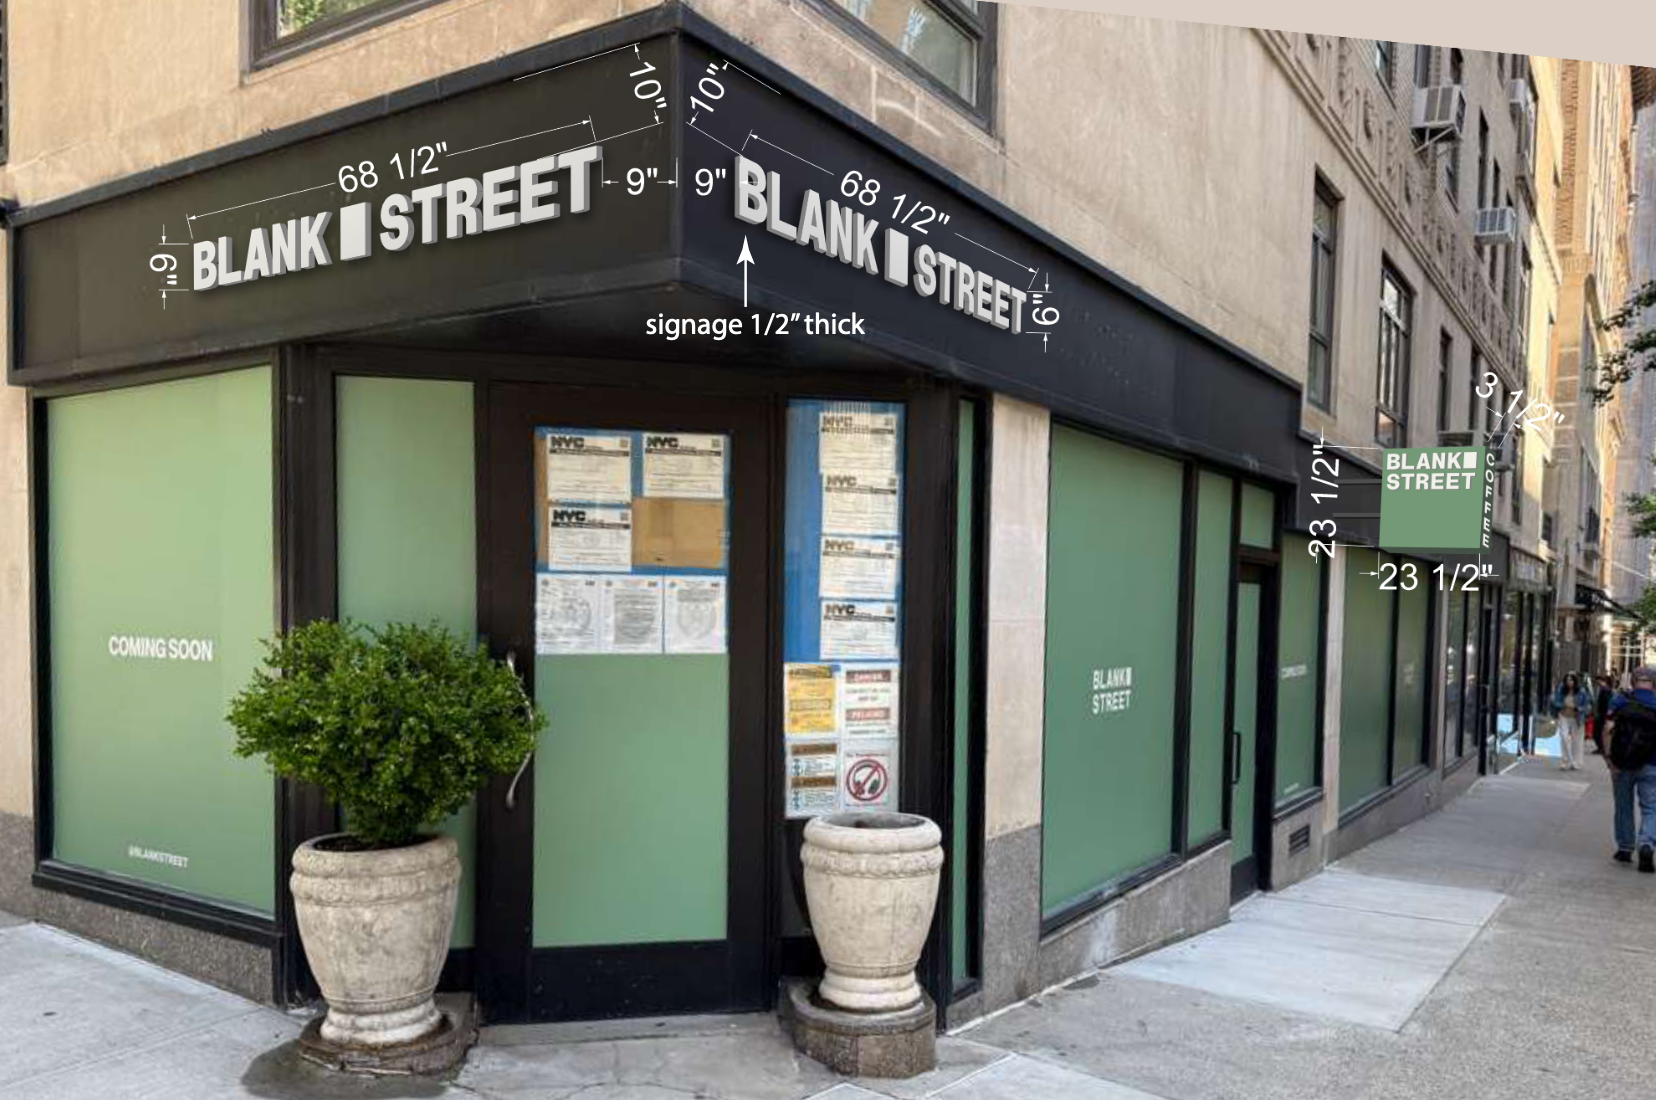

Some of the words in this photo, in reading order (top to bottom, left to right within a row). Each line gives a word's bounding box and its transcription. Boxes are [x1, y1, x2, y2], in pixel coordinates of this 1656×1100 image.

[193, 210, 333, 291] BLANK
[380, 145, 603, 251] STREET
[734, 154, 880, 276] BLANK
[913, 243, 1028, 335] STREET
[551, 436, 585, 448] NYC
[646, 437, 679, 448] NYC
[1386, 452, 1461, 471] BLANK
[1386, 472, 1476, 491] STREET
[1482, 453, 1496, 549] COFFEE
[553, 509, 587, 522] NYC
[109, 635, 167, 658] COMING
[168, 638, 213, 662] SOON
[1093, 668, 1126, 691] BLANK
[1092, 689, 1132, 715] STREET
